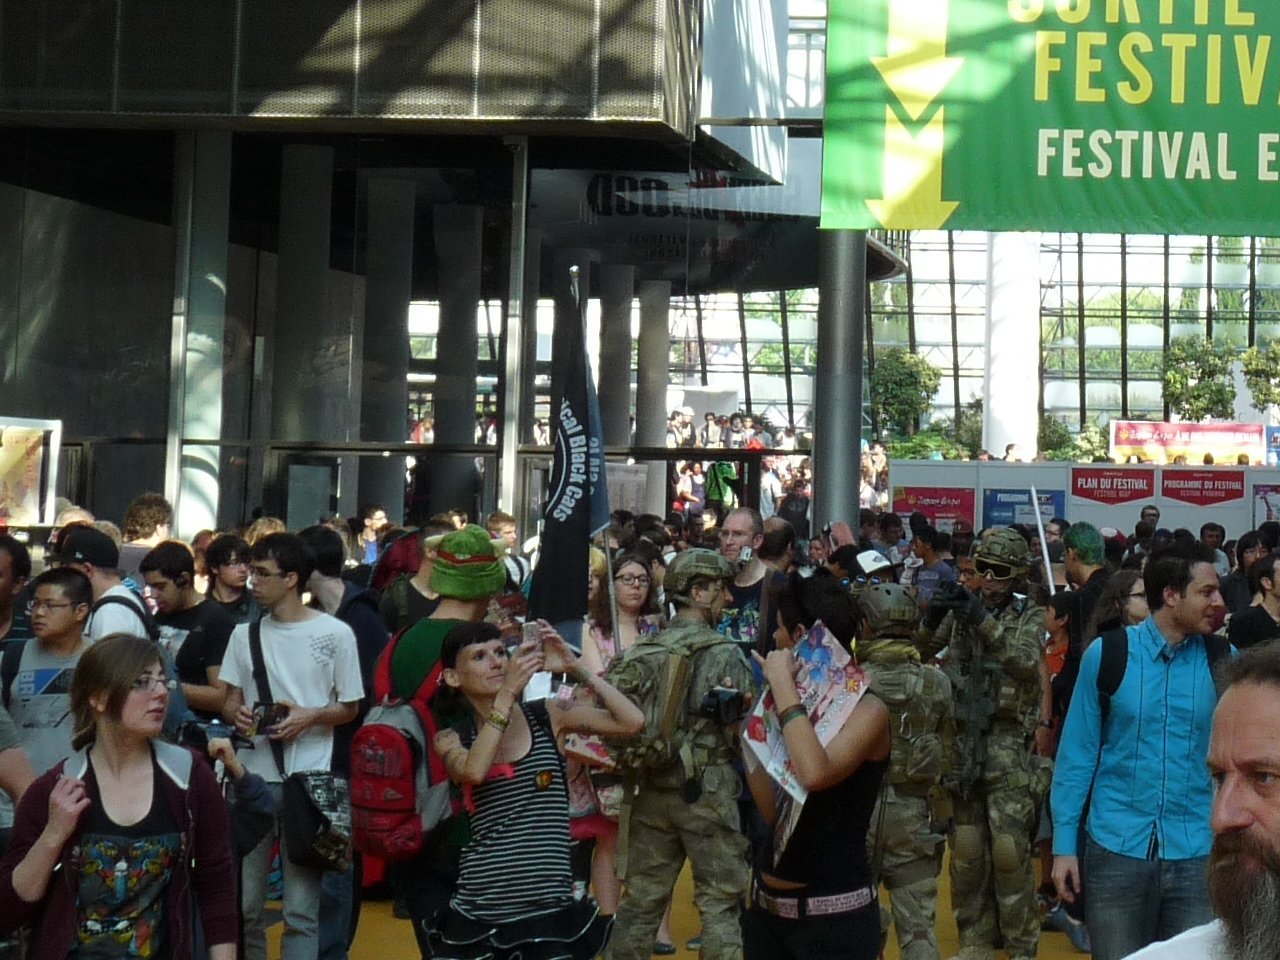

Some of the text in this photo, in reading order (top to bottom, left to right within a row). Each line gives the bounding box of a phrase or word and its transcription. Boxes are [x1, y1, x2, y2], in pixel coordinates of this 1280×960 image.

[1037, 128, 1236, 181] FESTIVAL
[569, 435, 588, 484] Black
[1078, 478, 1148, 490] PLAN DU FESTIVAL
[1215, 480, 1243, 490] FESTIVAL
[553, 485, 583, 522] Cats
